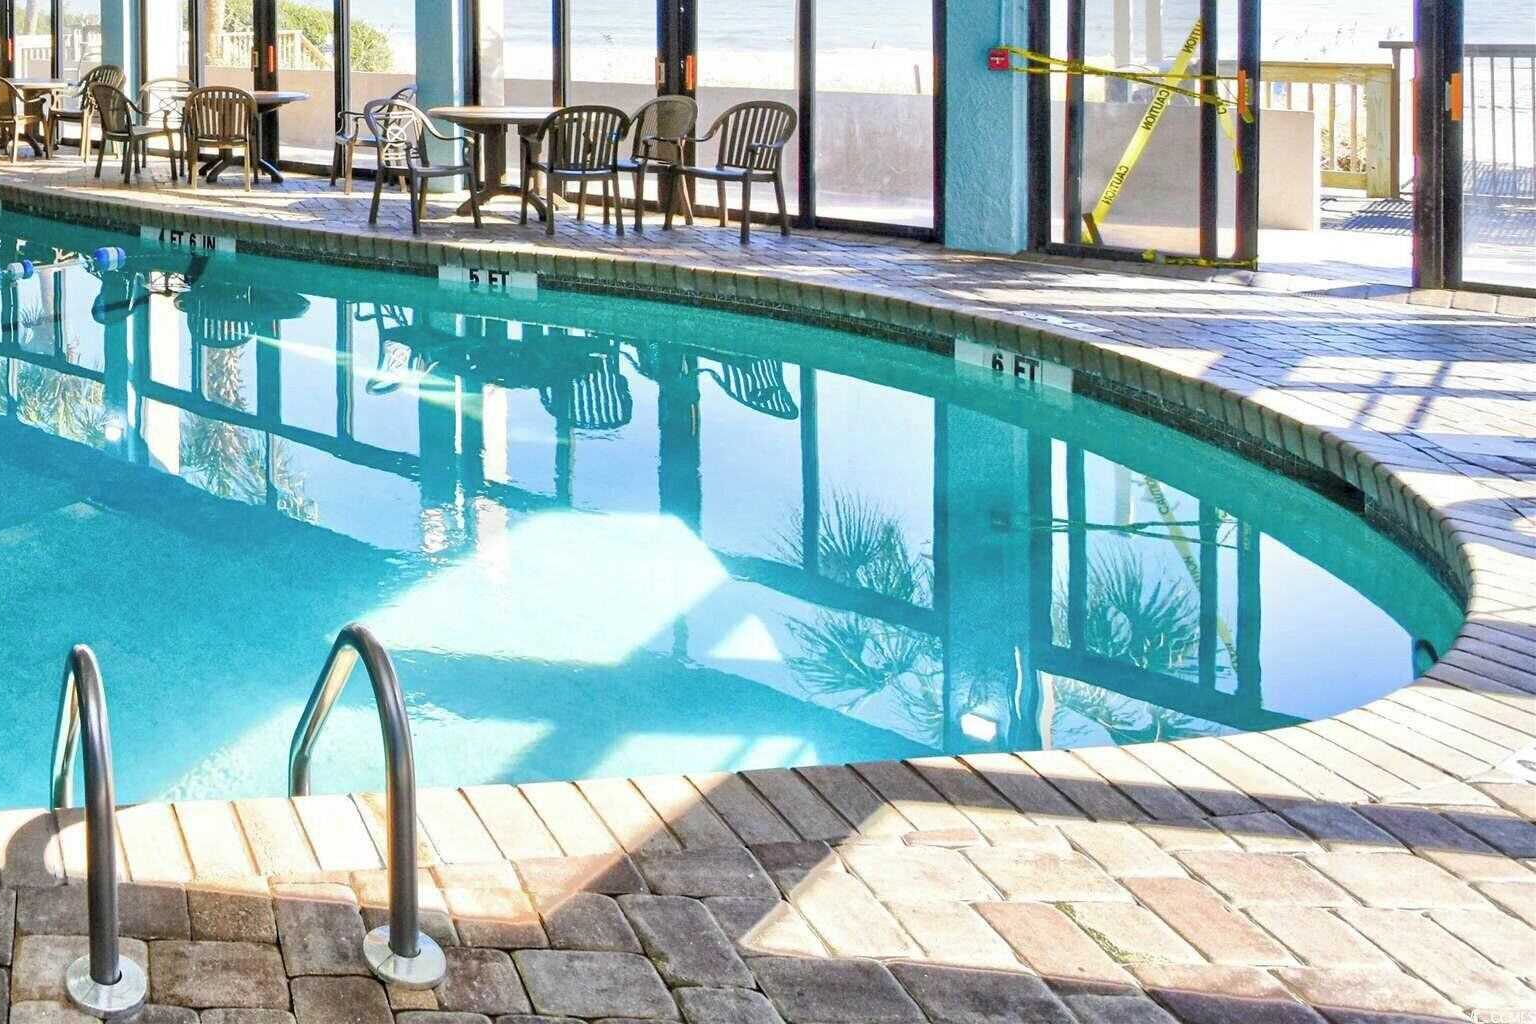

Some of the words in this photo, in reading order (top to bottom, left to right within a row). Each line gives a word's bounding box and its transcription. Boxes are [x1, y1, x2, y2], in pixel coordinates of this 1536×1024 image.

[203, 234, 216, 250] IN
[469, 267, 479, 283] 5
[487, 269, 510, 287] FT
[991, 352, 1004, 372] 6
[1014, 355, 1040, 381] FT
